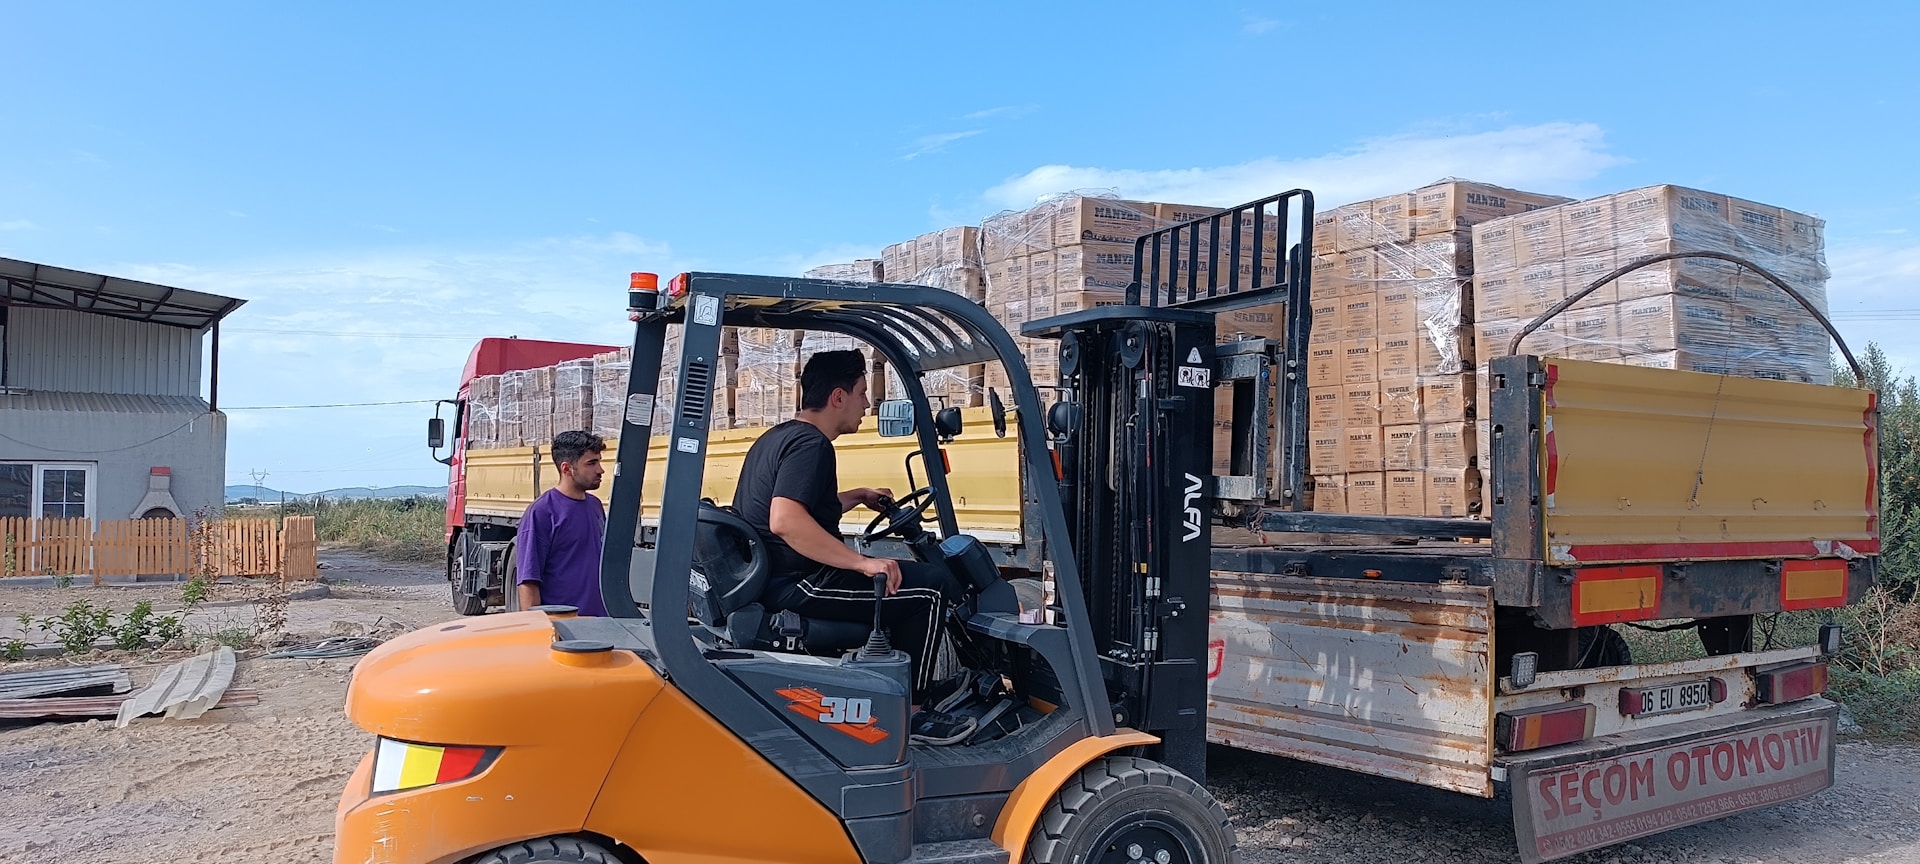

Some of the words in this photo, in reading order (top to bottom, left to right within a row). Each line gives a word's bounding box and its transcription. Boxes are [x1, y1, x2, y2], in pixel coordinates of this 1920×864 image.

[1466, 192, 1506, 208] MANYAK
[819, 696, 872, 724] 30
[1641, 691, 1654, 712] 06
[1660, 688, 1674, 710] EU
[1680, 684, 1706, 706] 8950
[1540, 757, 1656, 821] SEÇOM
